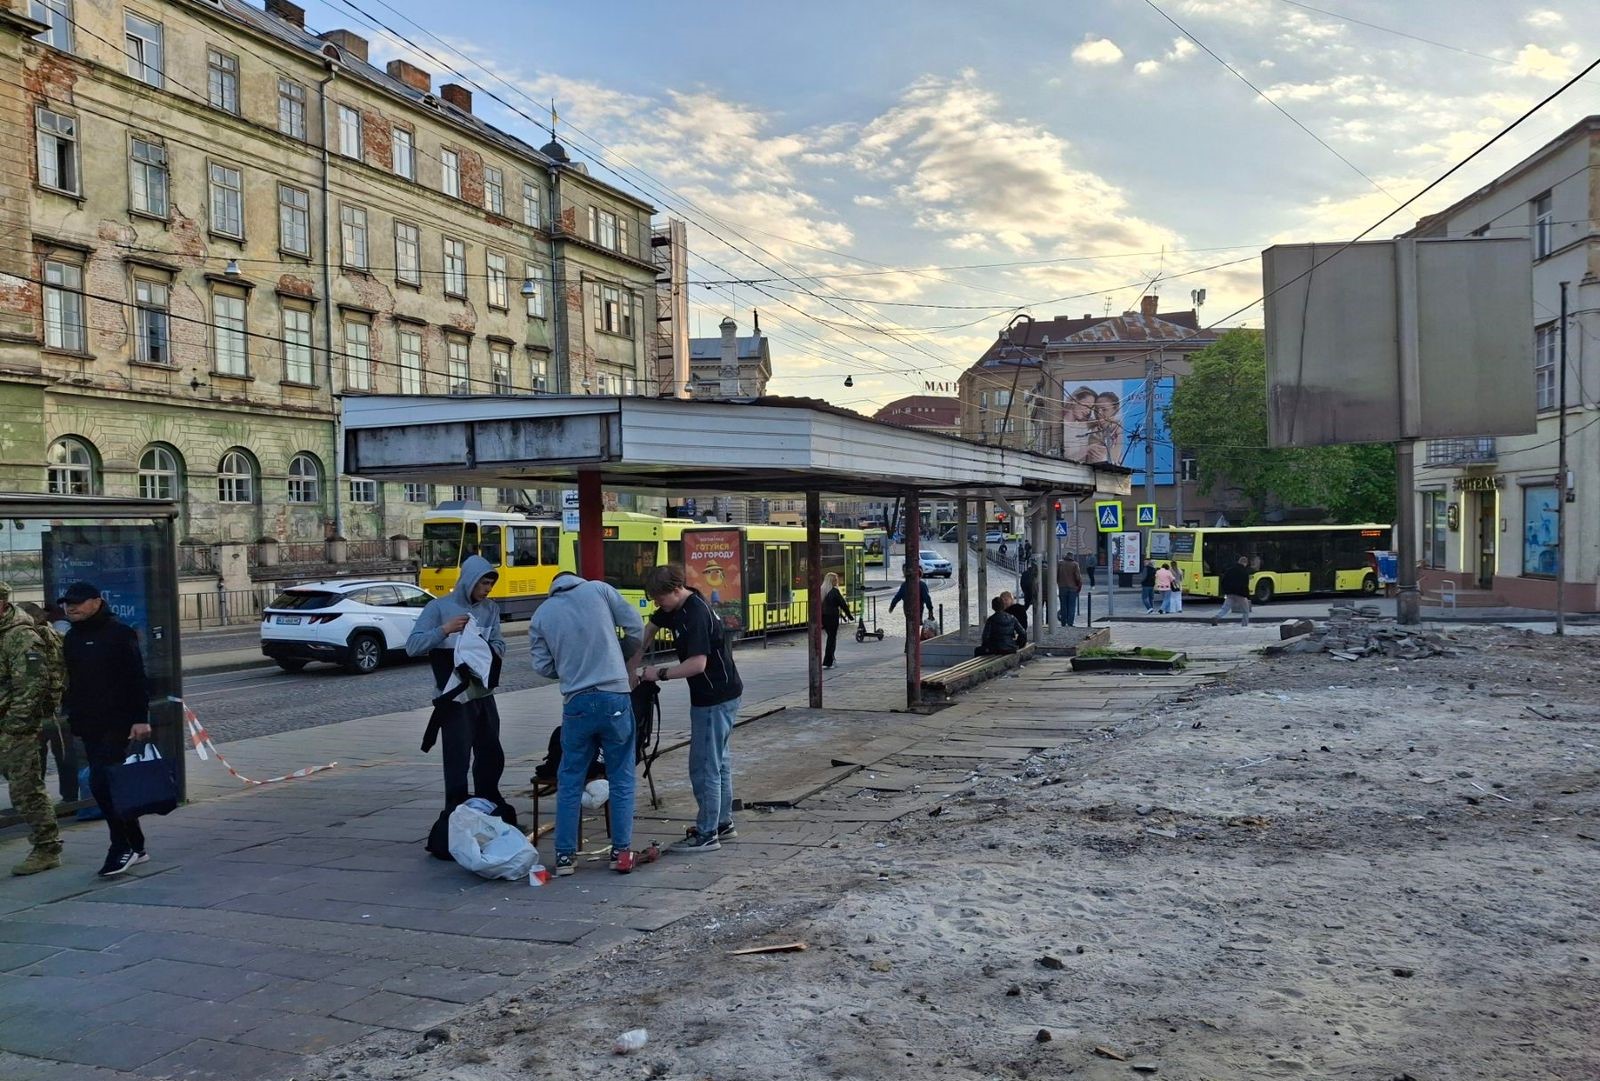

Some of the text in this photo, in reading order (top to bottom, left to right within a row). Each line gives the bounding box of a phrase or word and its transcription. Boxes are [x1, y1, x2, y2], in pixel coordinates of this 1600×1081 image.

[696, 543, 729, 551] ГОТУЙСЯ
[691, 551, 734, 560] ДО ГОРОДУ
